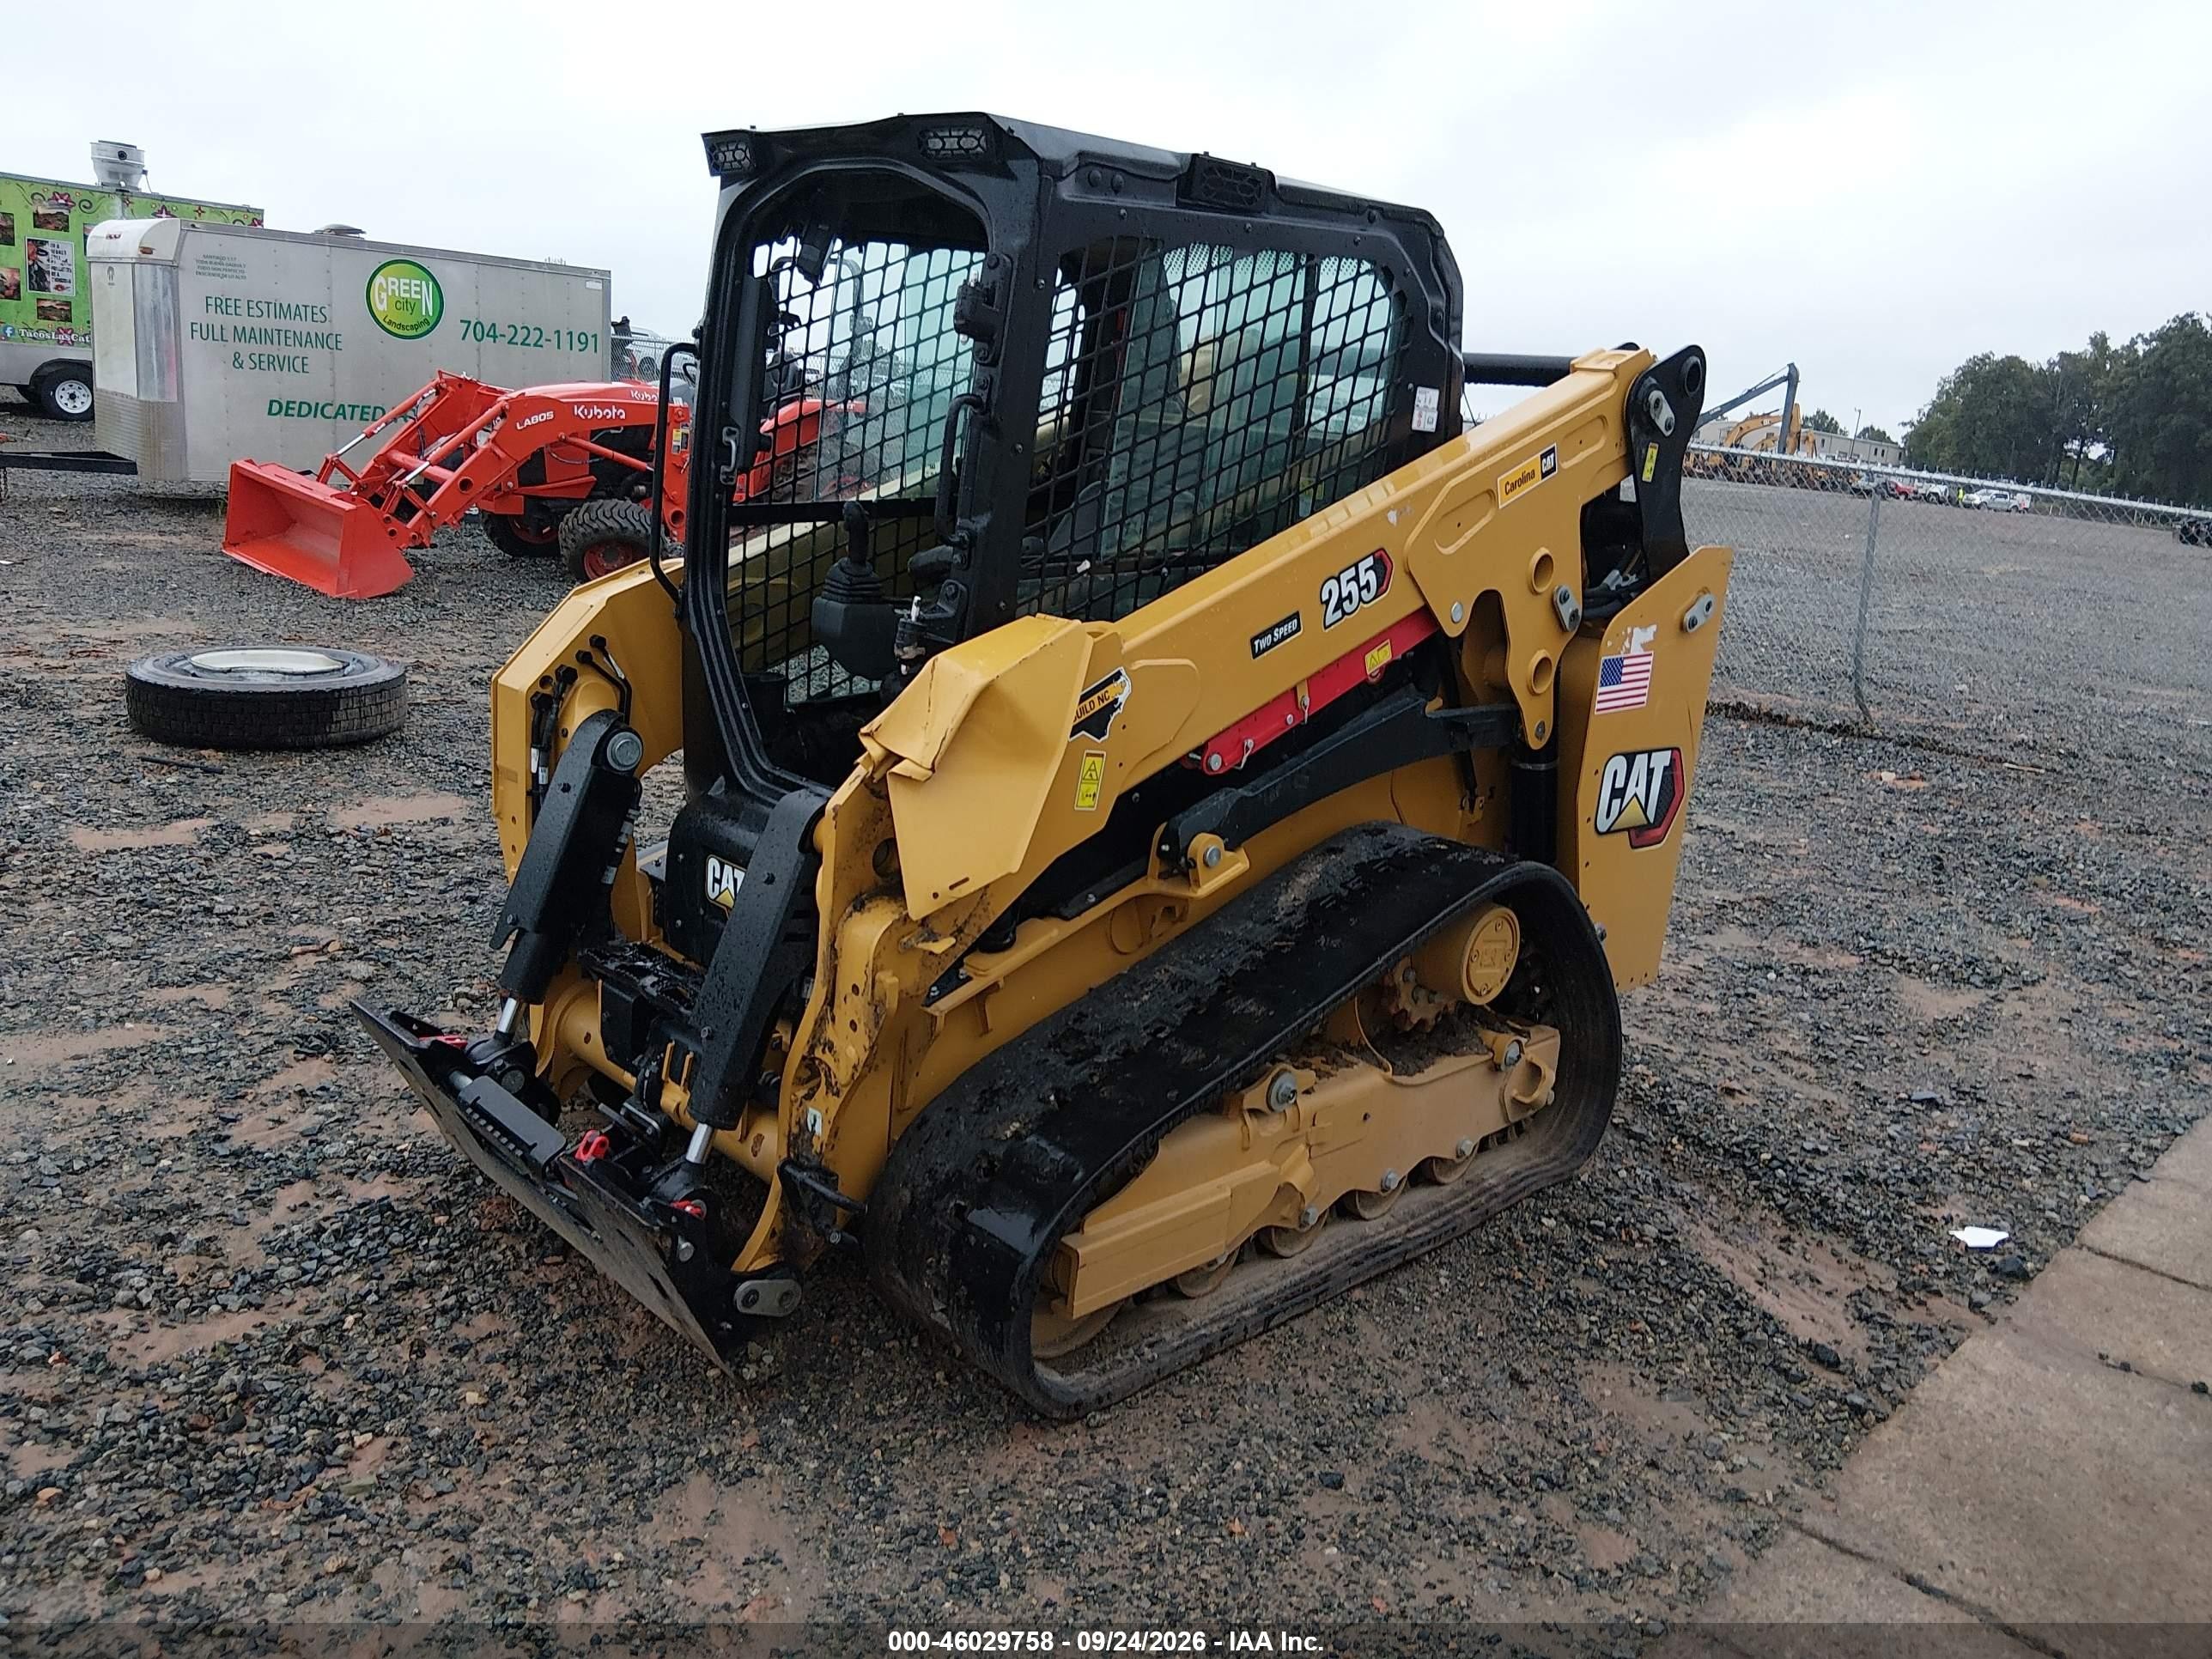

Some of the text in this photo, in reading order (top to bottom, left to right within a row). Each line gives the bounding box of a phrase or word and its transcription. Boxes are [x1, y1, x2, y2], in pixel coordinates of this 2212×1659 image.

[205, 295, 327, 324] FREE ESTIMATES
[374, 275, 433, 317] GREEN
[394, 296, 416, 315] city
[190, 322, 343, 350] FULL MAINTENANCE
[383, 314, 430, 332] Landscaping
[459, 319, 598, 354] 704-222-1191
[232, 351, 310, 374] & SERVICE
[267, 398, 386, 422] DEDICATED
[516, 410, 554, 430] LA805
[574, 404, 626, 420] Kubota
[1504, 453, 1554, 495] Carolina CAT
[1321, 554, 1377, 628] 255
[1073, 690, 1110, 723] UILD NC
[1596, 750, 1672, 833] CAT
